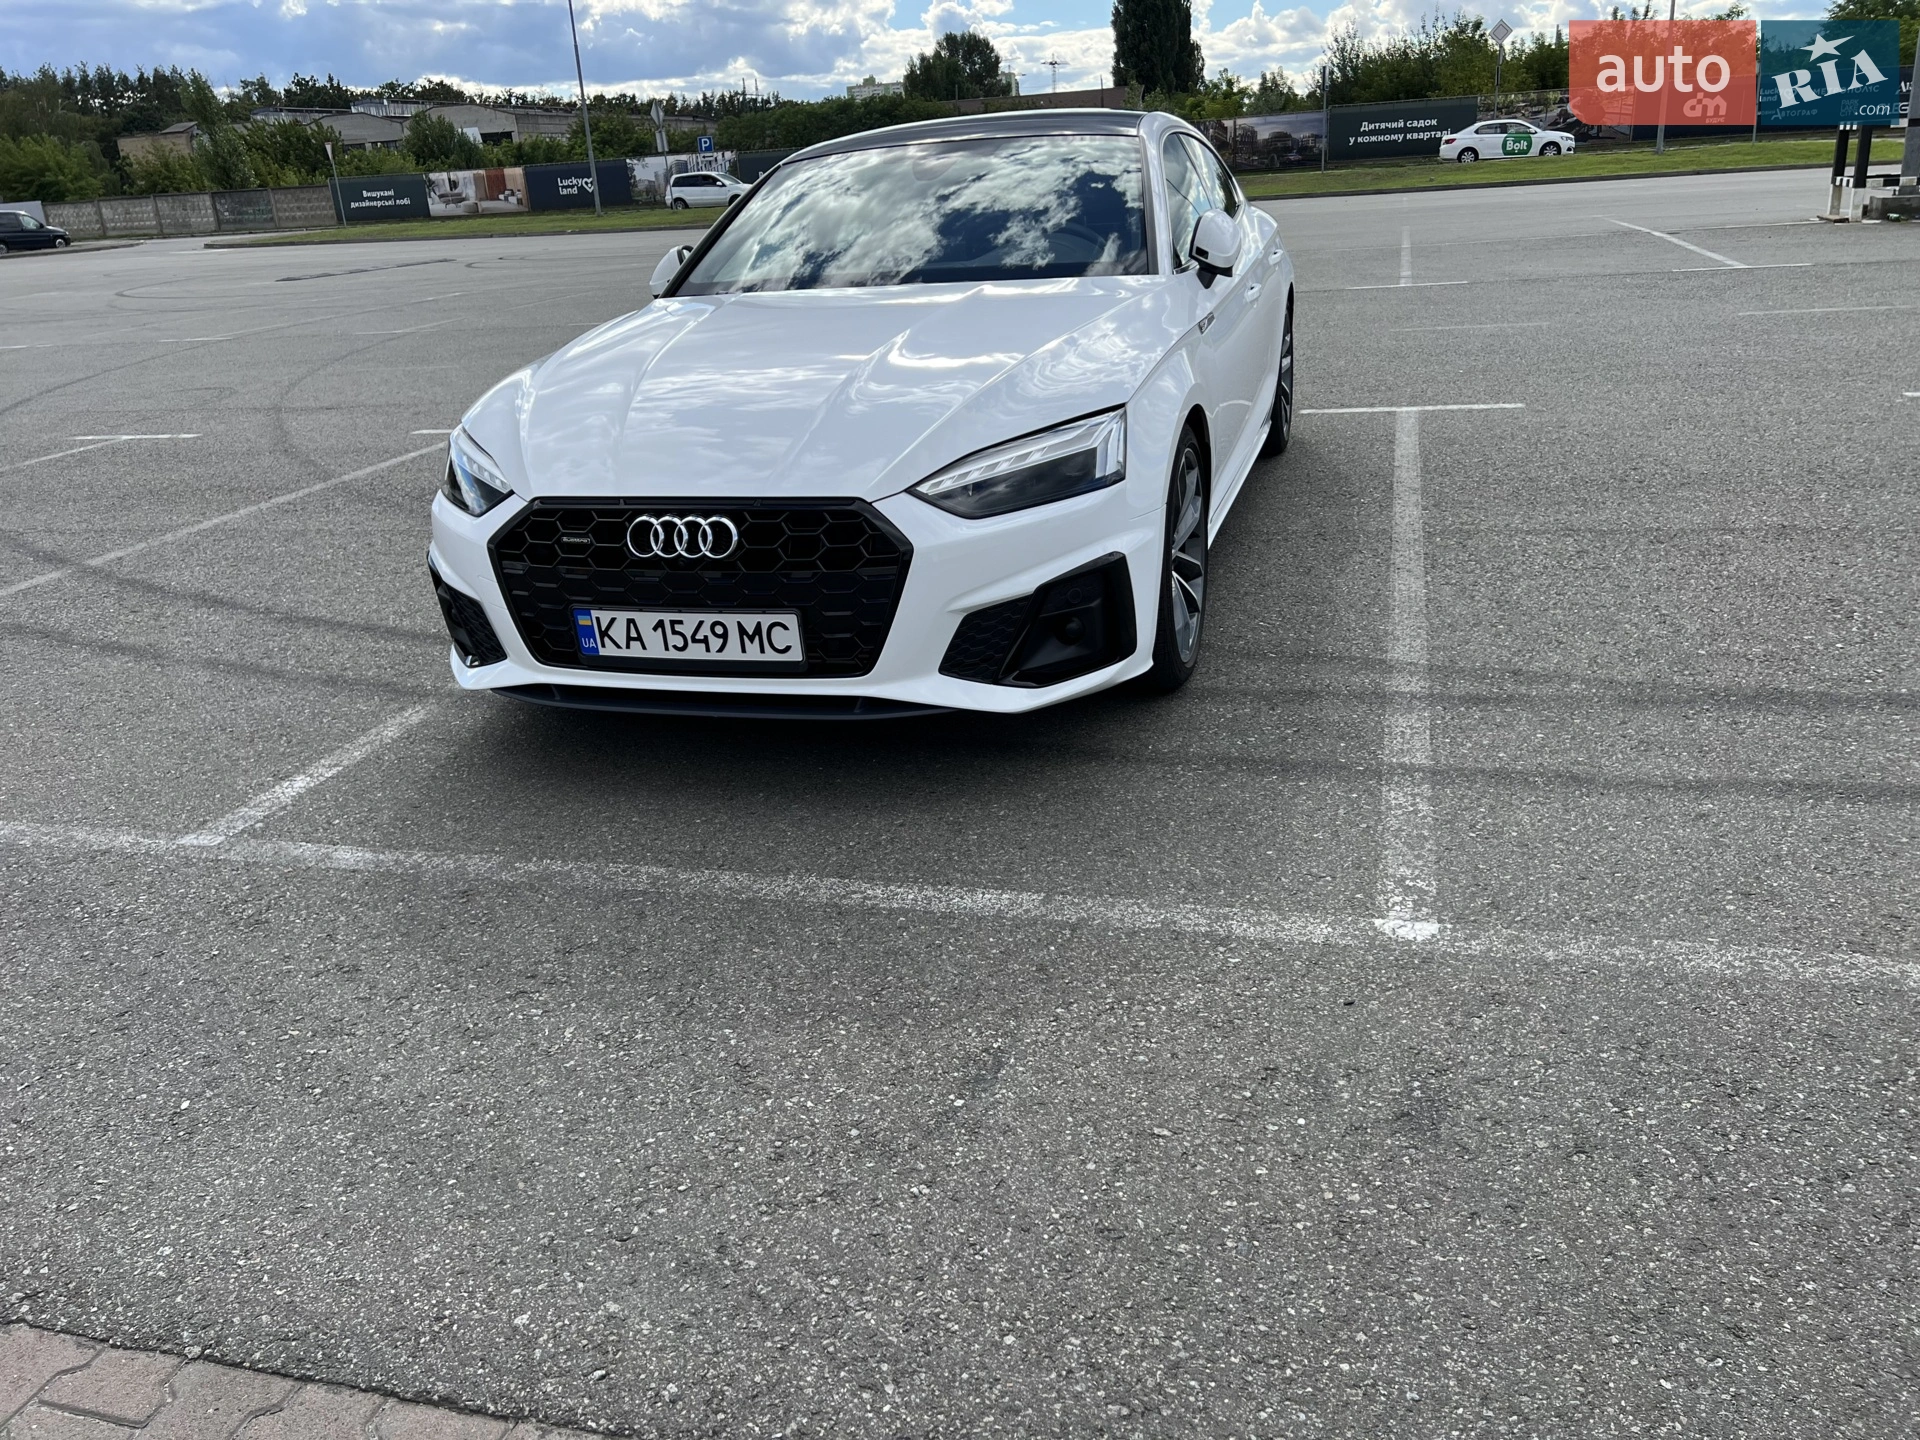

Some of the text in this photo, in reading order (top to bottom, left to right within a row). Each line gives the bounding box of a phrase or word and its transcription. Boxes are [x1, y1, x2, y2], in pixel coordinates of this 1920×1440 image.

[1360, 118, 1438, 132] Дитячий садок
[1349, 128, 1451, 146] у кожному кварталі
[701, 138, 710, 151] P
[1505, 138, 1528, 153] Bolt
[557, 176, 582, 187] Lucky
[362, 189, 394, 198] Вишукані
[559, 186, 578, 195] land
[350, 197, 411, 209] дизайнерські лобі
[581, 616, 792, 654] UA KA 1549 MC
